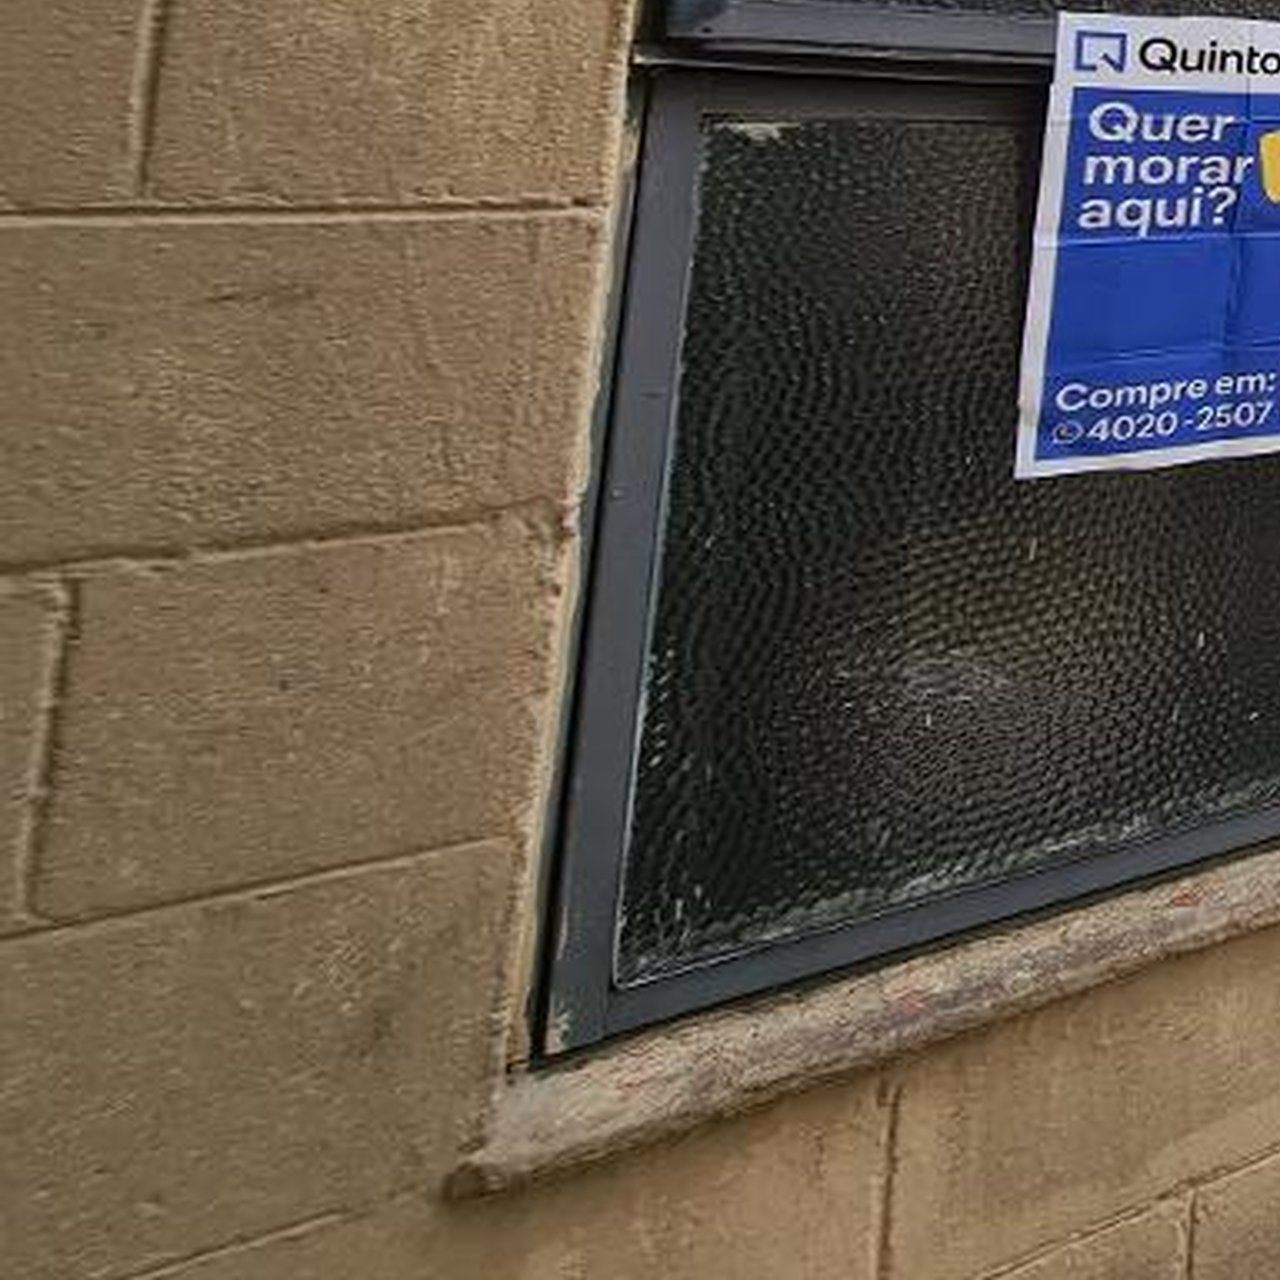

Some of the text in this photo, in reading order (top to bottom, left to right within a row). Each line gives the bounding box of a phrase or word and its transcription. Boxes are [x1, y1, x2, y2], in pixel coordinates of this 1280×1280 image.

[1088, 101, 1234, 143] Quer
[1084, 153, 1254, 185] morar
[1078, 186, 1237, 237] aqui?
[1055, 372, 1277, 411] Compre em:
